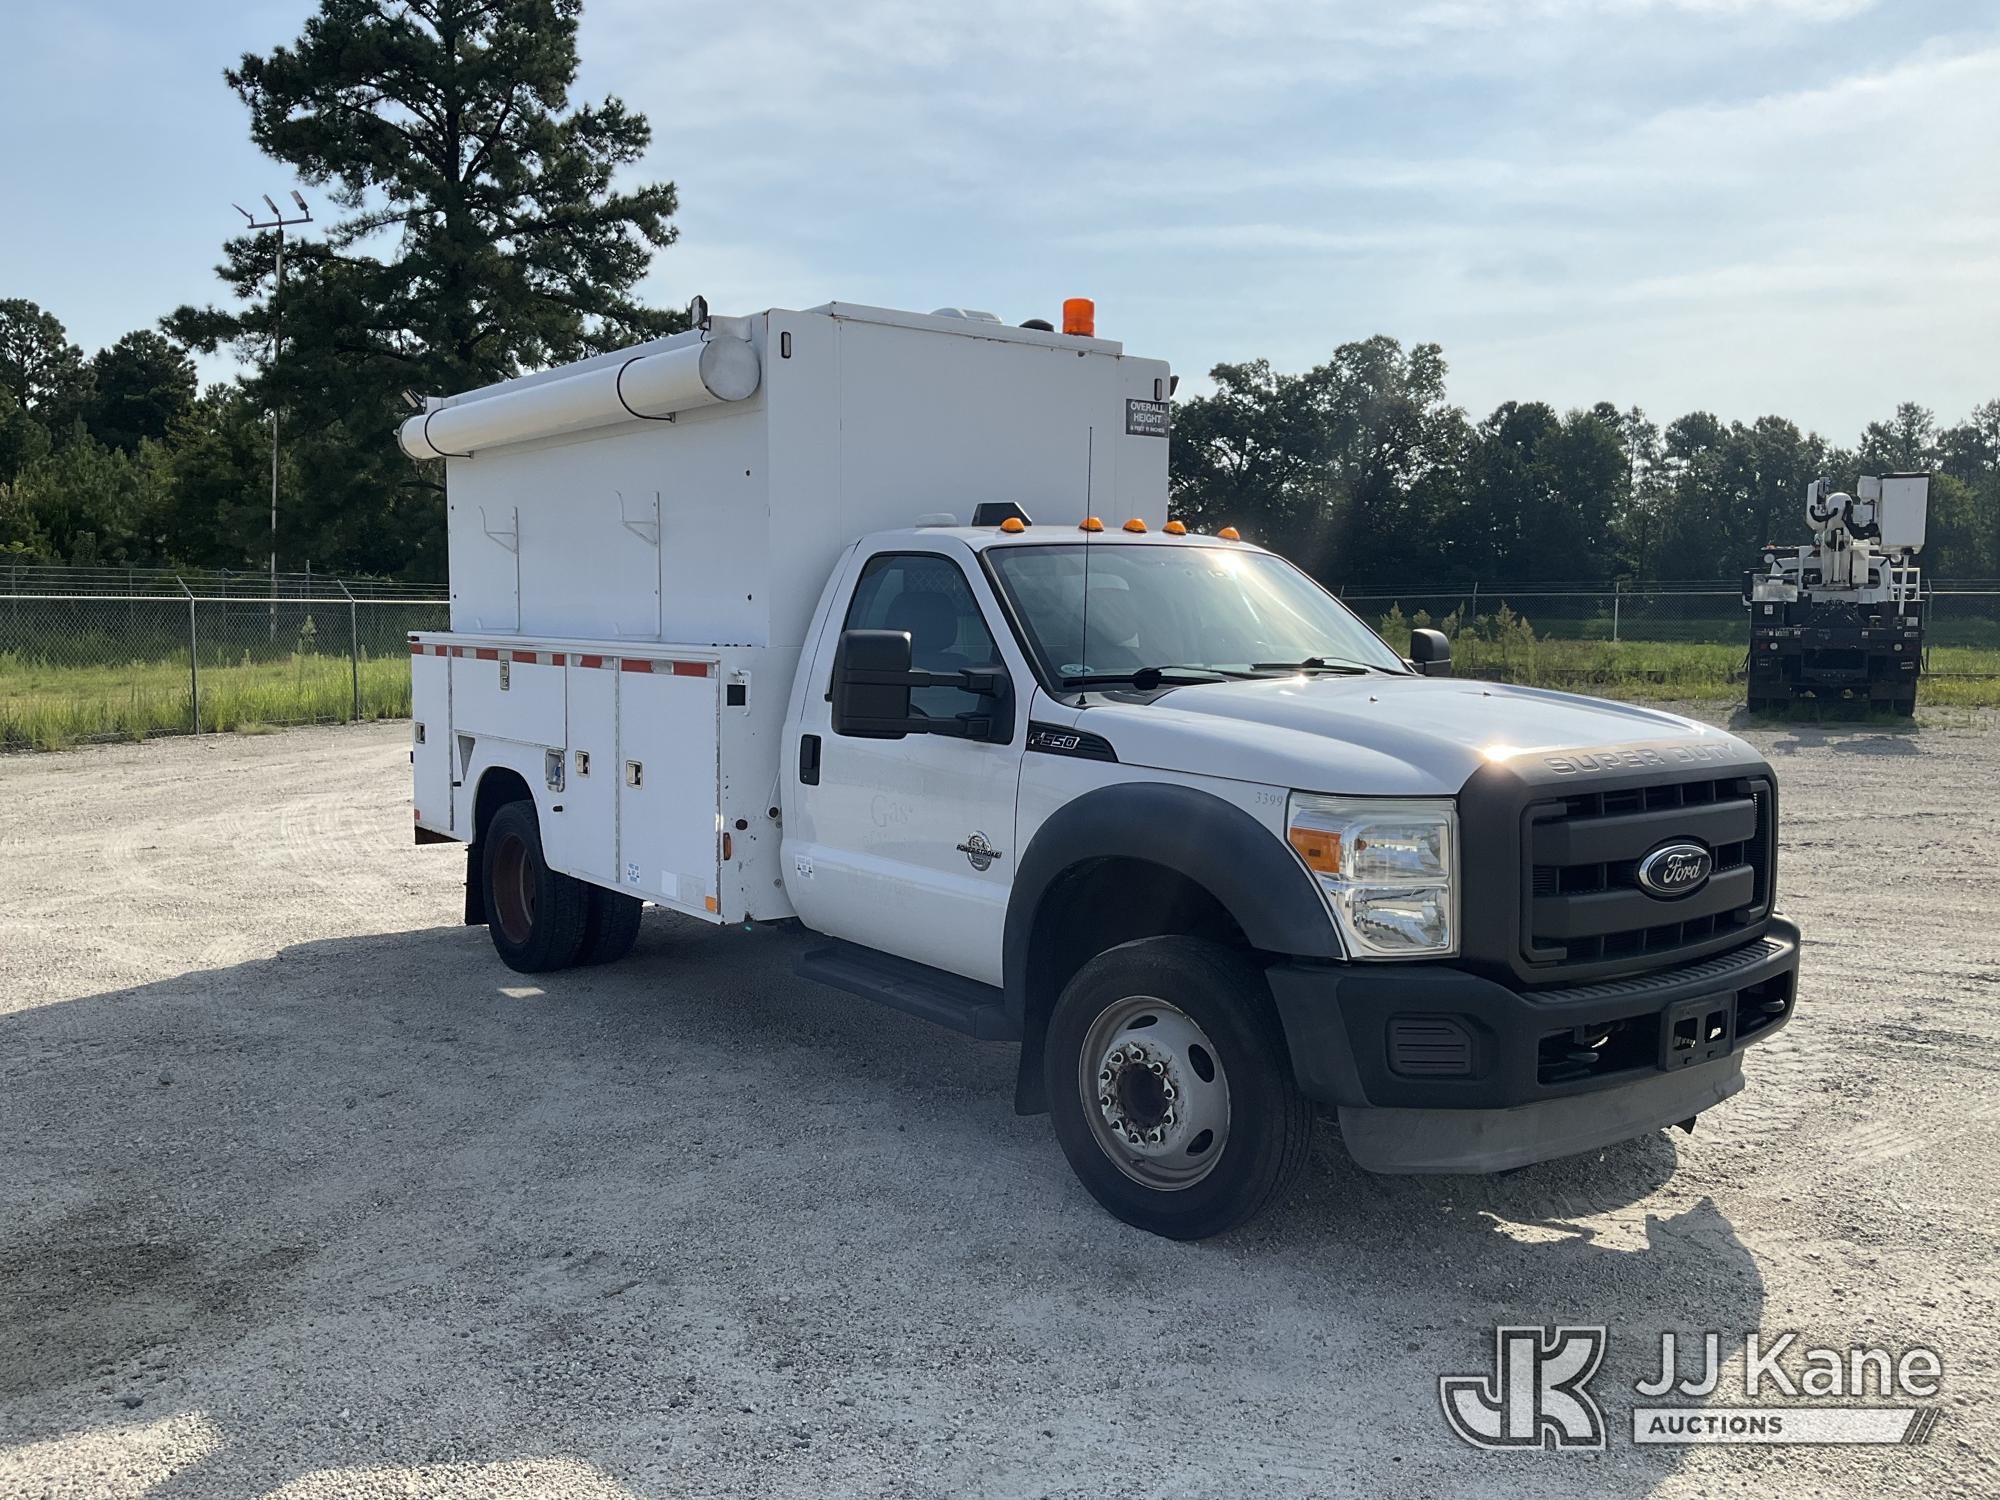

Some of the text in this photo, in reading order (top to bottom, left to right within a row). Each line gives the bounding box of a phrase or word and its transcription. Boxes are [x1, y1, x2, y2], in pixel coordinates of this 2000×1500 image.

[1130, 401, 1165, 413] OVERALL
[1133, 413, 1162, 423] HEIGHT
[1543, 742, 1740, 775] SUPER DUTY
[1255, 791, 1284, 807] 3399
[1663, 853, 1702, 884] Ford
